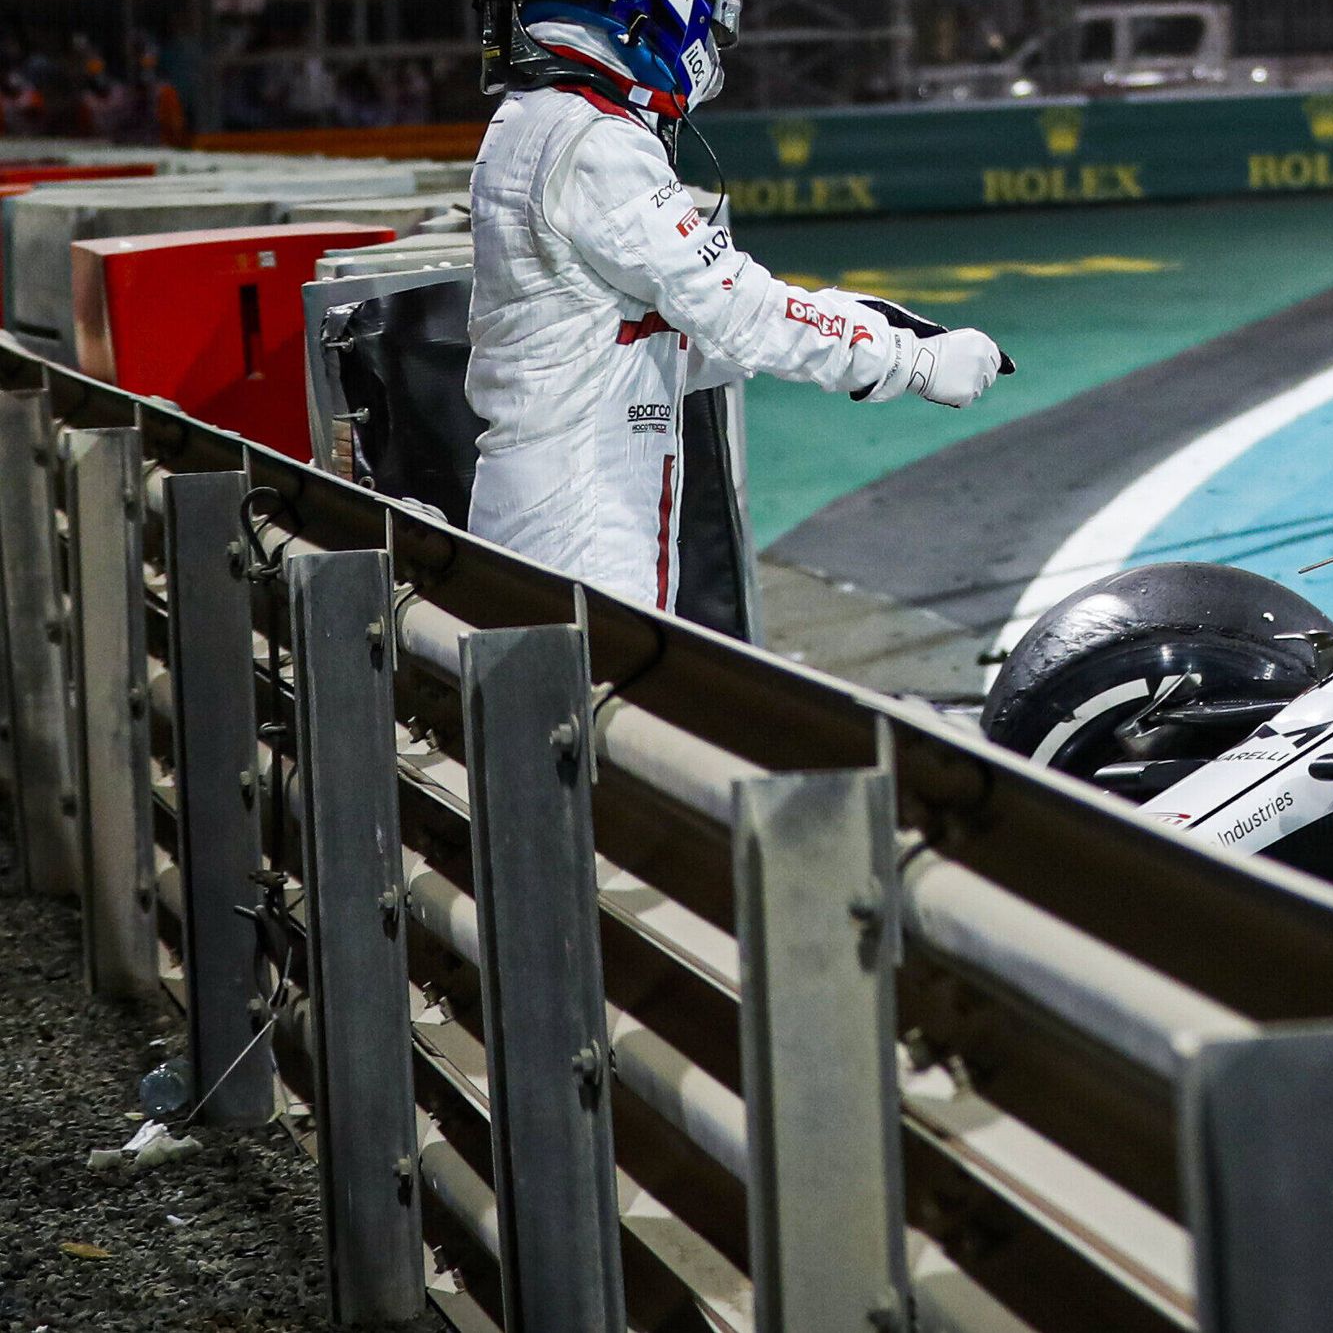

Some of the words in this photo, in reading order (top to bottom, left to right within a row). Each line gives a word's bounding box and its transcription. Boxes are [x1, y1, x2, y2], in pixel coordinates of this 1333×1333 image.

[982, 165, 1143, 205] ROLEX
[627, 404, 671, 420] sparco
[1217, 791, 1294, 847] Industries
